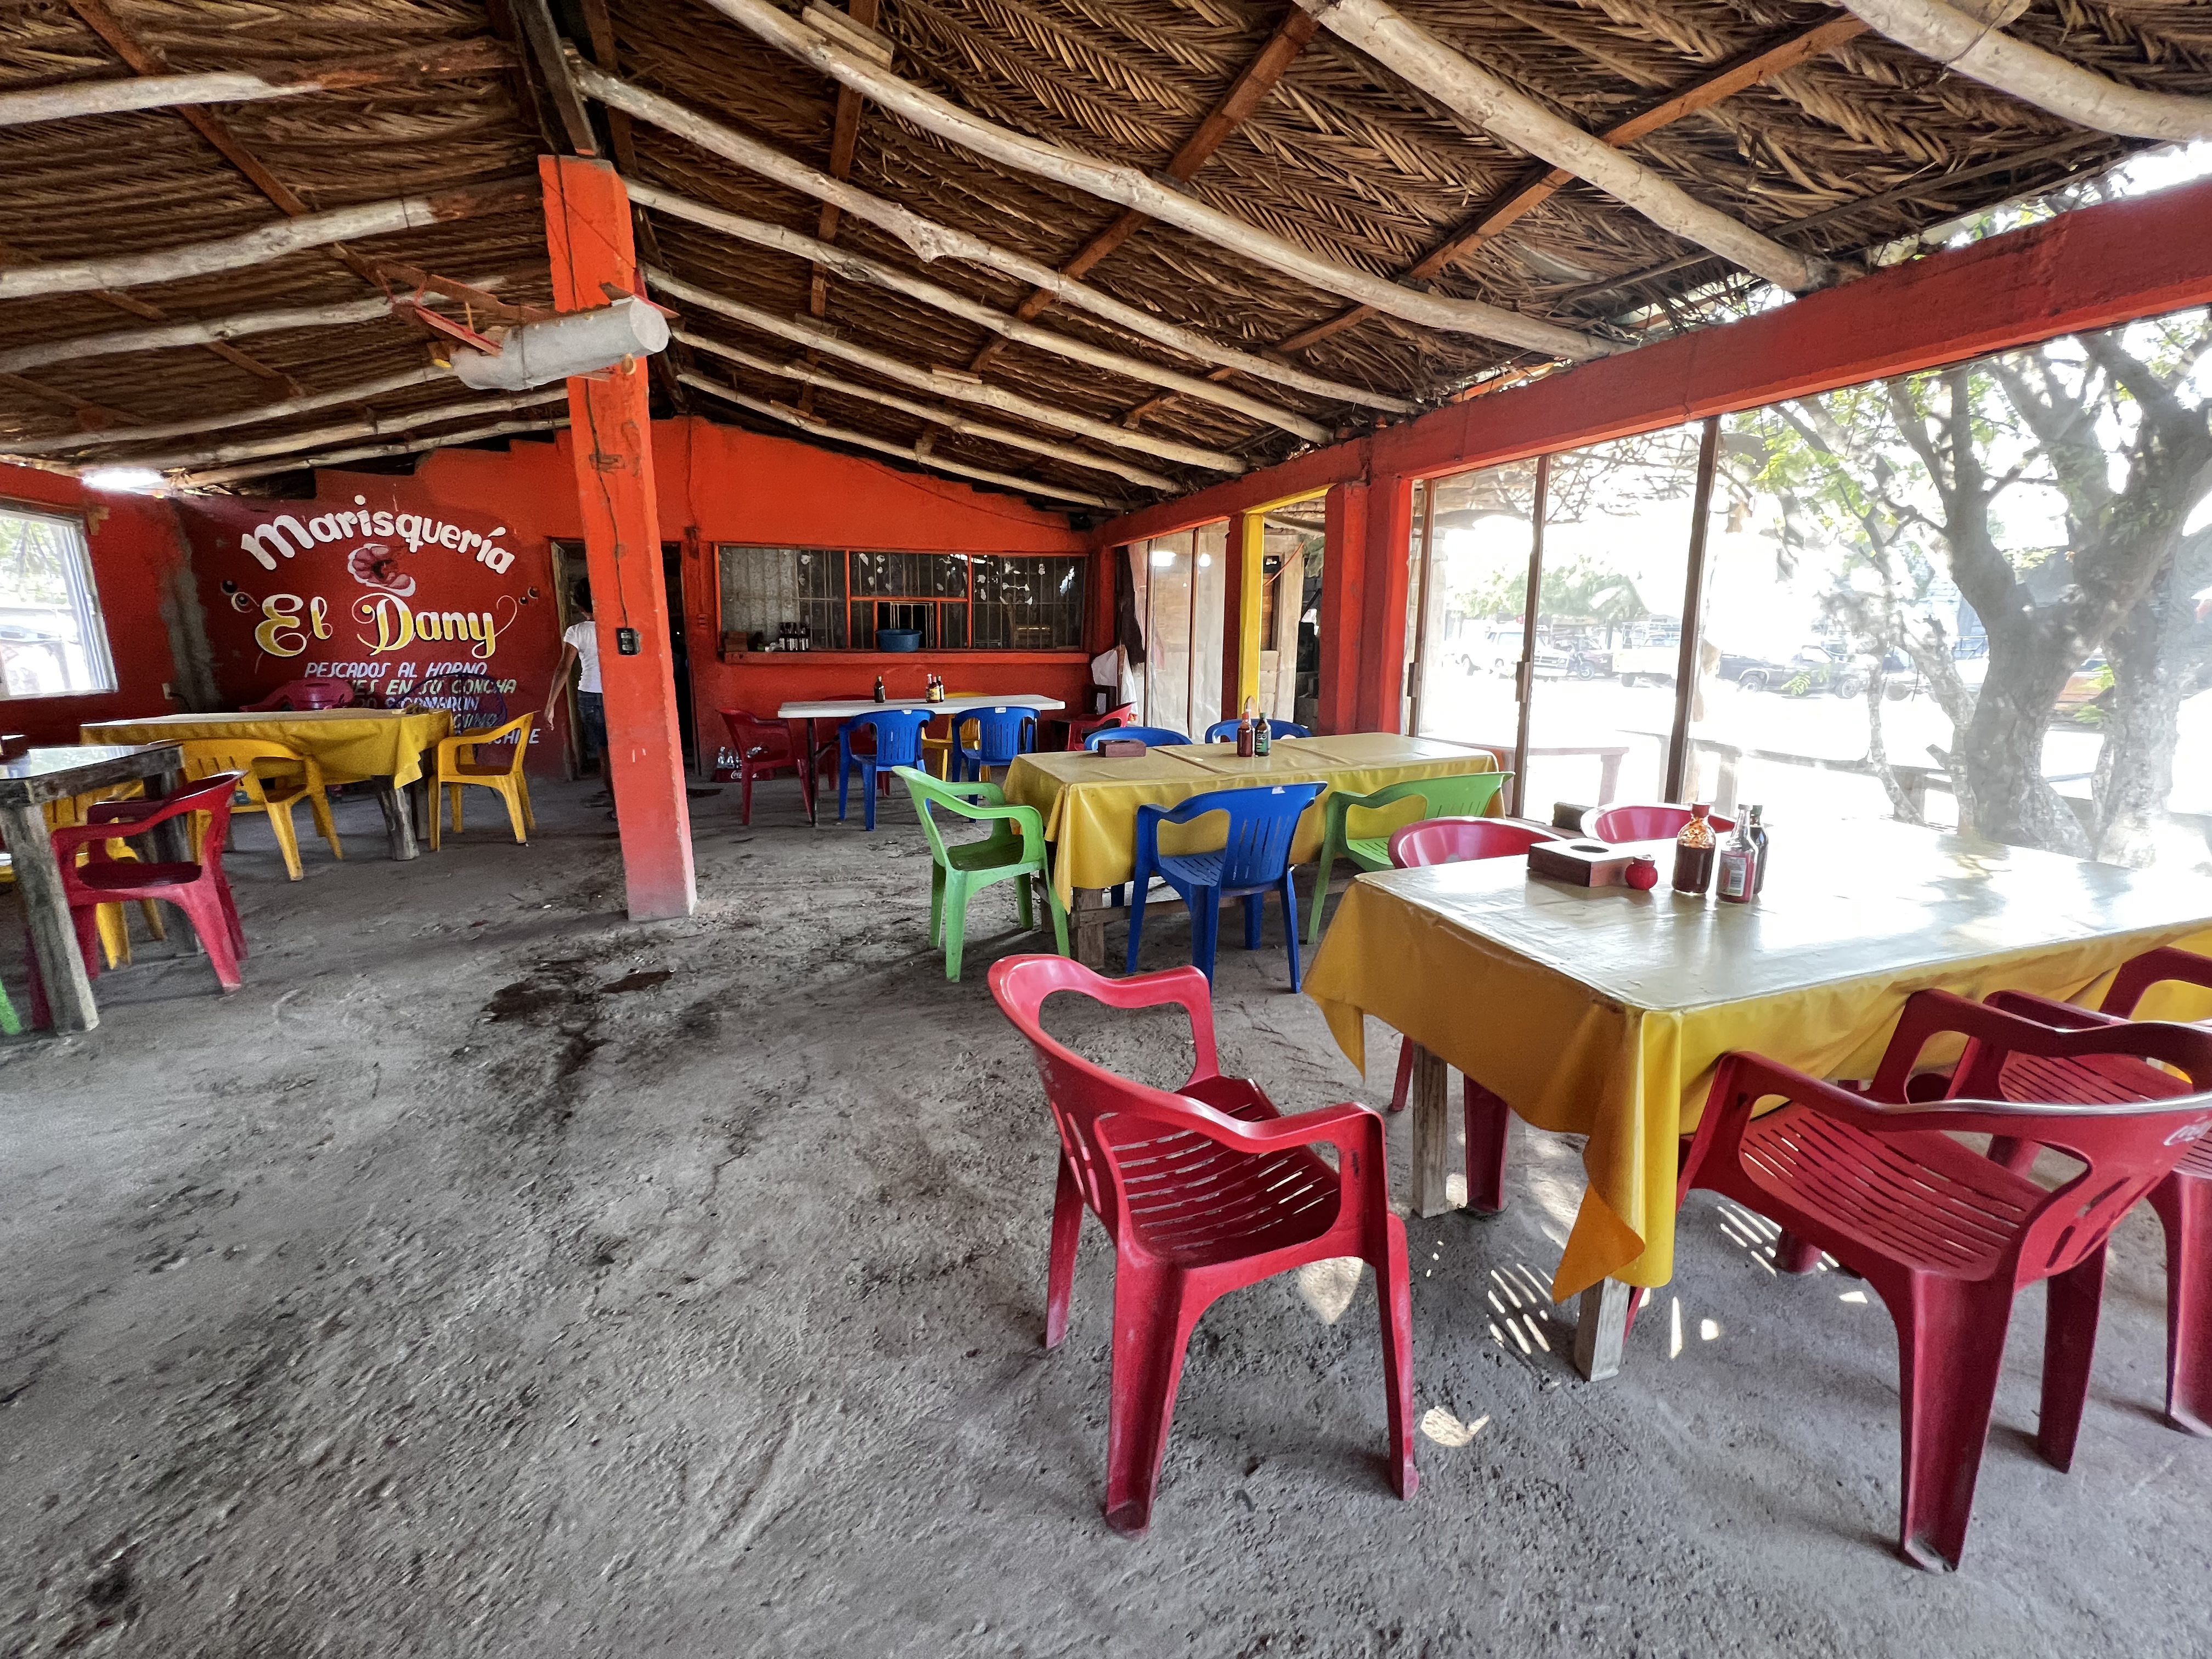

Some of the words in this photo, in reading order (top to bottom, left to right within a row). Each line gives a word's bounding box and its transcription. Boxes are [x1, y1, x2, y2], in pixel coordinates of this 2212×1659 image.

[241, 495, 515, 574] Marisquería
[255, 594, 332, 657] El
[351, 592, 517, 658] Dany
[304, 662, 391, 678] PESCADOS
[398, 662, 417, 678] AL
[425, 662, 487, 678] HORNO
[386, 679, 413, 695] EN
[418, 679, 443, 695] SU
